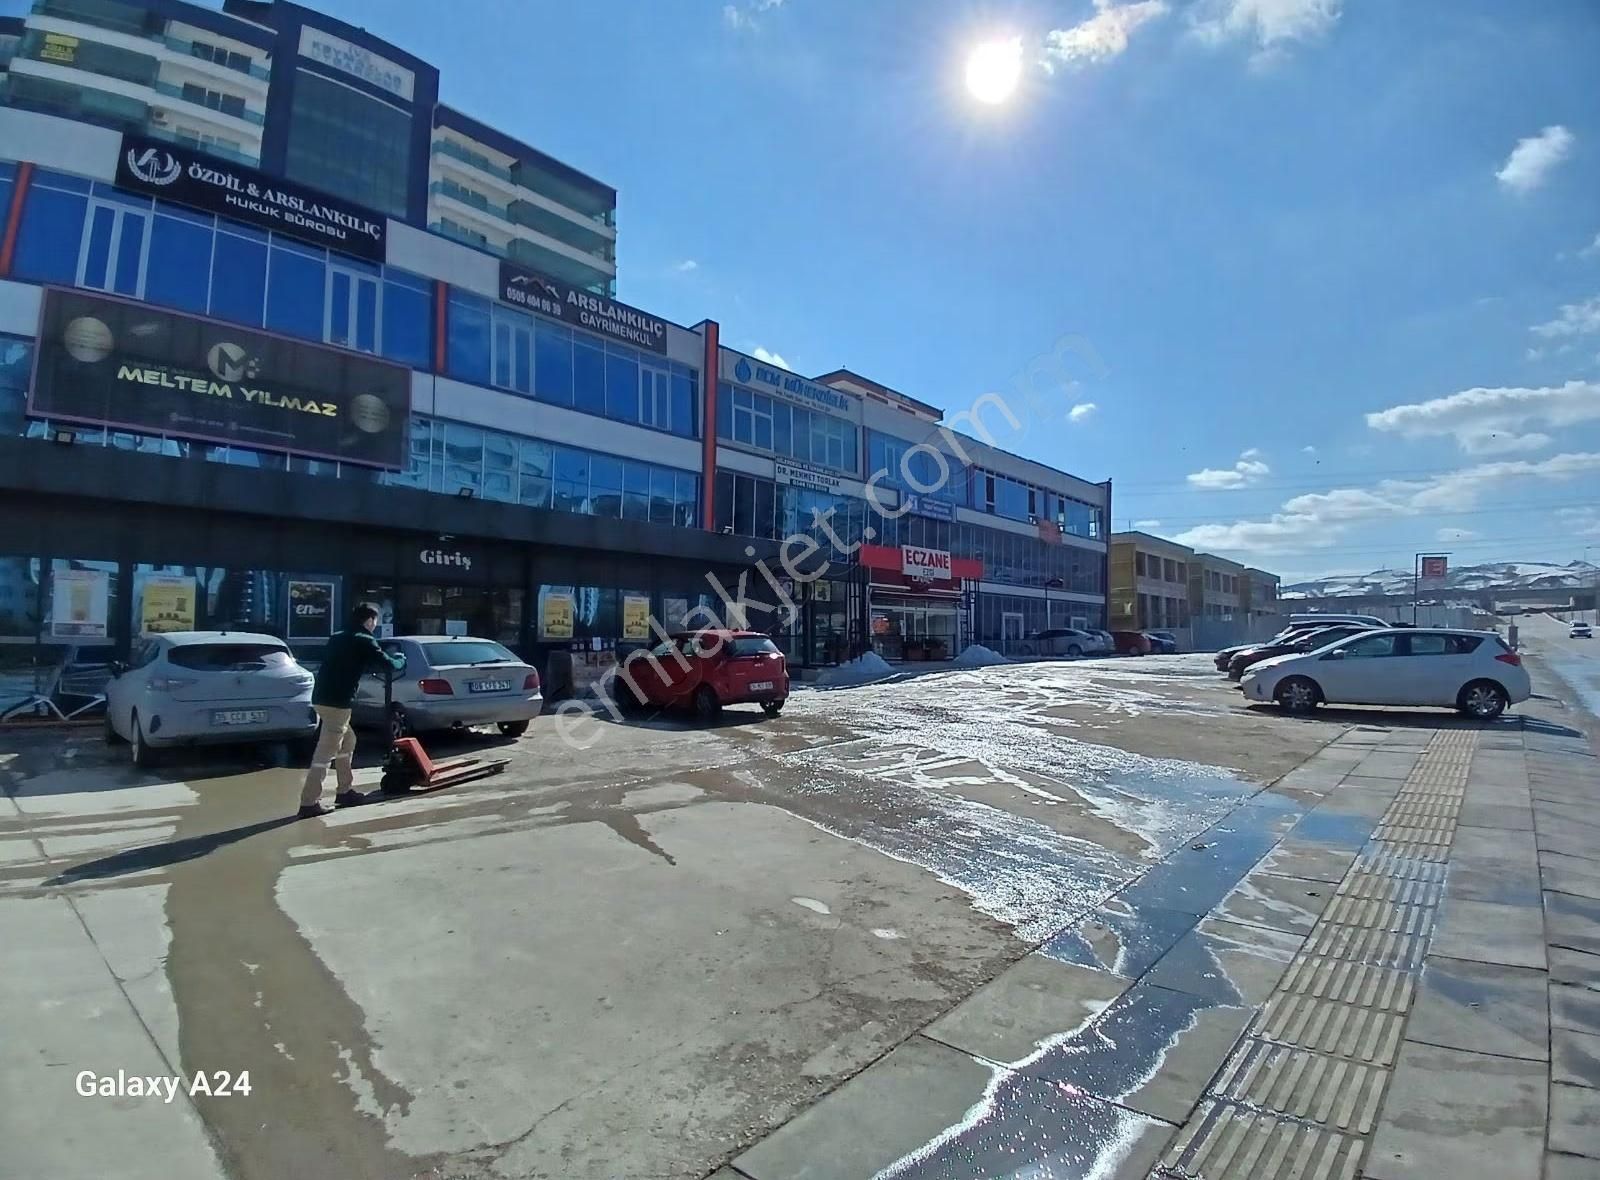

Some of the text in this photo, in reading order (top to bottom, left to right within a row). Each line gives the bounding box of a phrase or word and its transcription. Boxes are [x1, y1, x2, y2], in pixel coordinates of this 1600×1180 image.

[188, 161, 381, 240] ÖZDİL & ARSLANKILIÇ
[225, 194, 346, 240] HUKUK BÜROSU
[567, 290, 663, 338] ARSLANKILIÇ
[580, 311, 652, 346] GAYRİMENKUL
[117, 365, 233, 399] MELTEM
[240, 386, 338, 417] YILMAZ
[419, 550, 472, 570] Giriş
[905, 549, 950, 570] ECZANE
